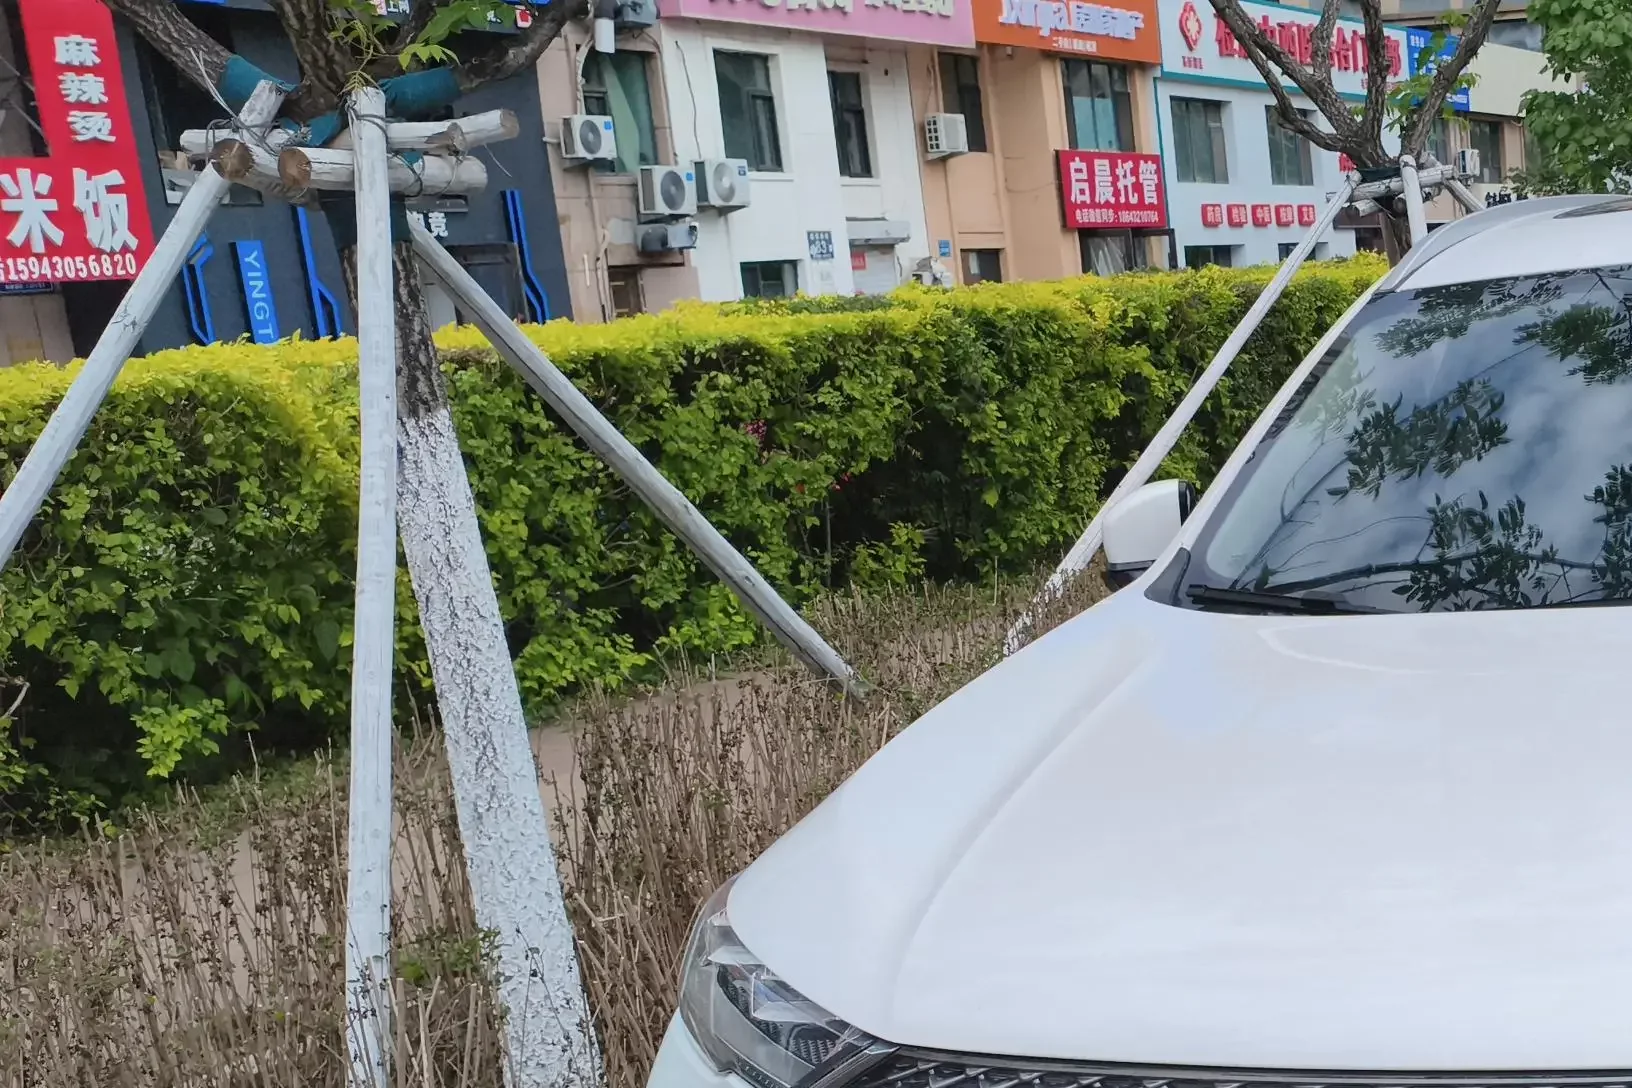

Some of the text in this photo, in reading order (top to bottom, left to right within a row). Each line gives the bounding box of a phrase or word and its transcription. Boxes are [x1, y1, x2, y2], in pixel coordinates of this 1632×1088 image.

[53, 34, 117, 144] 麻辣烫
[0, 167, 139, 254] 米饭
[1069, 156, 1159, 205] 启晨托管
[6, 252, 137, 281] 15943056820
